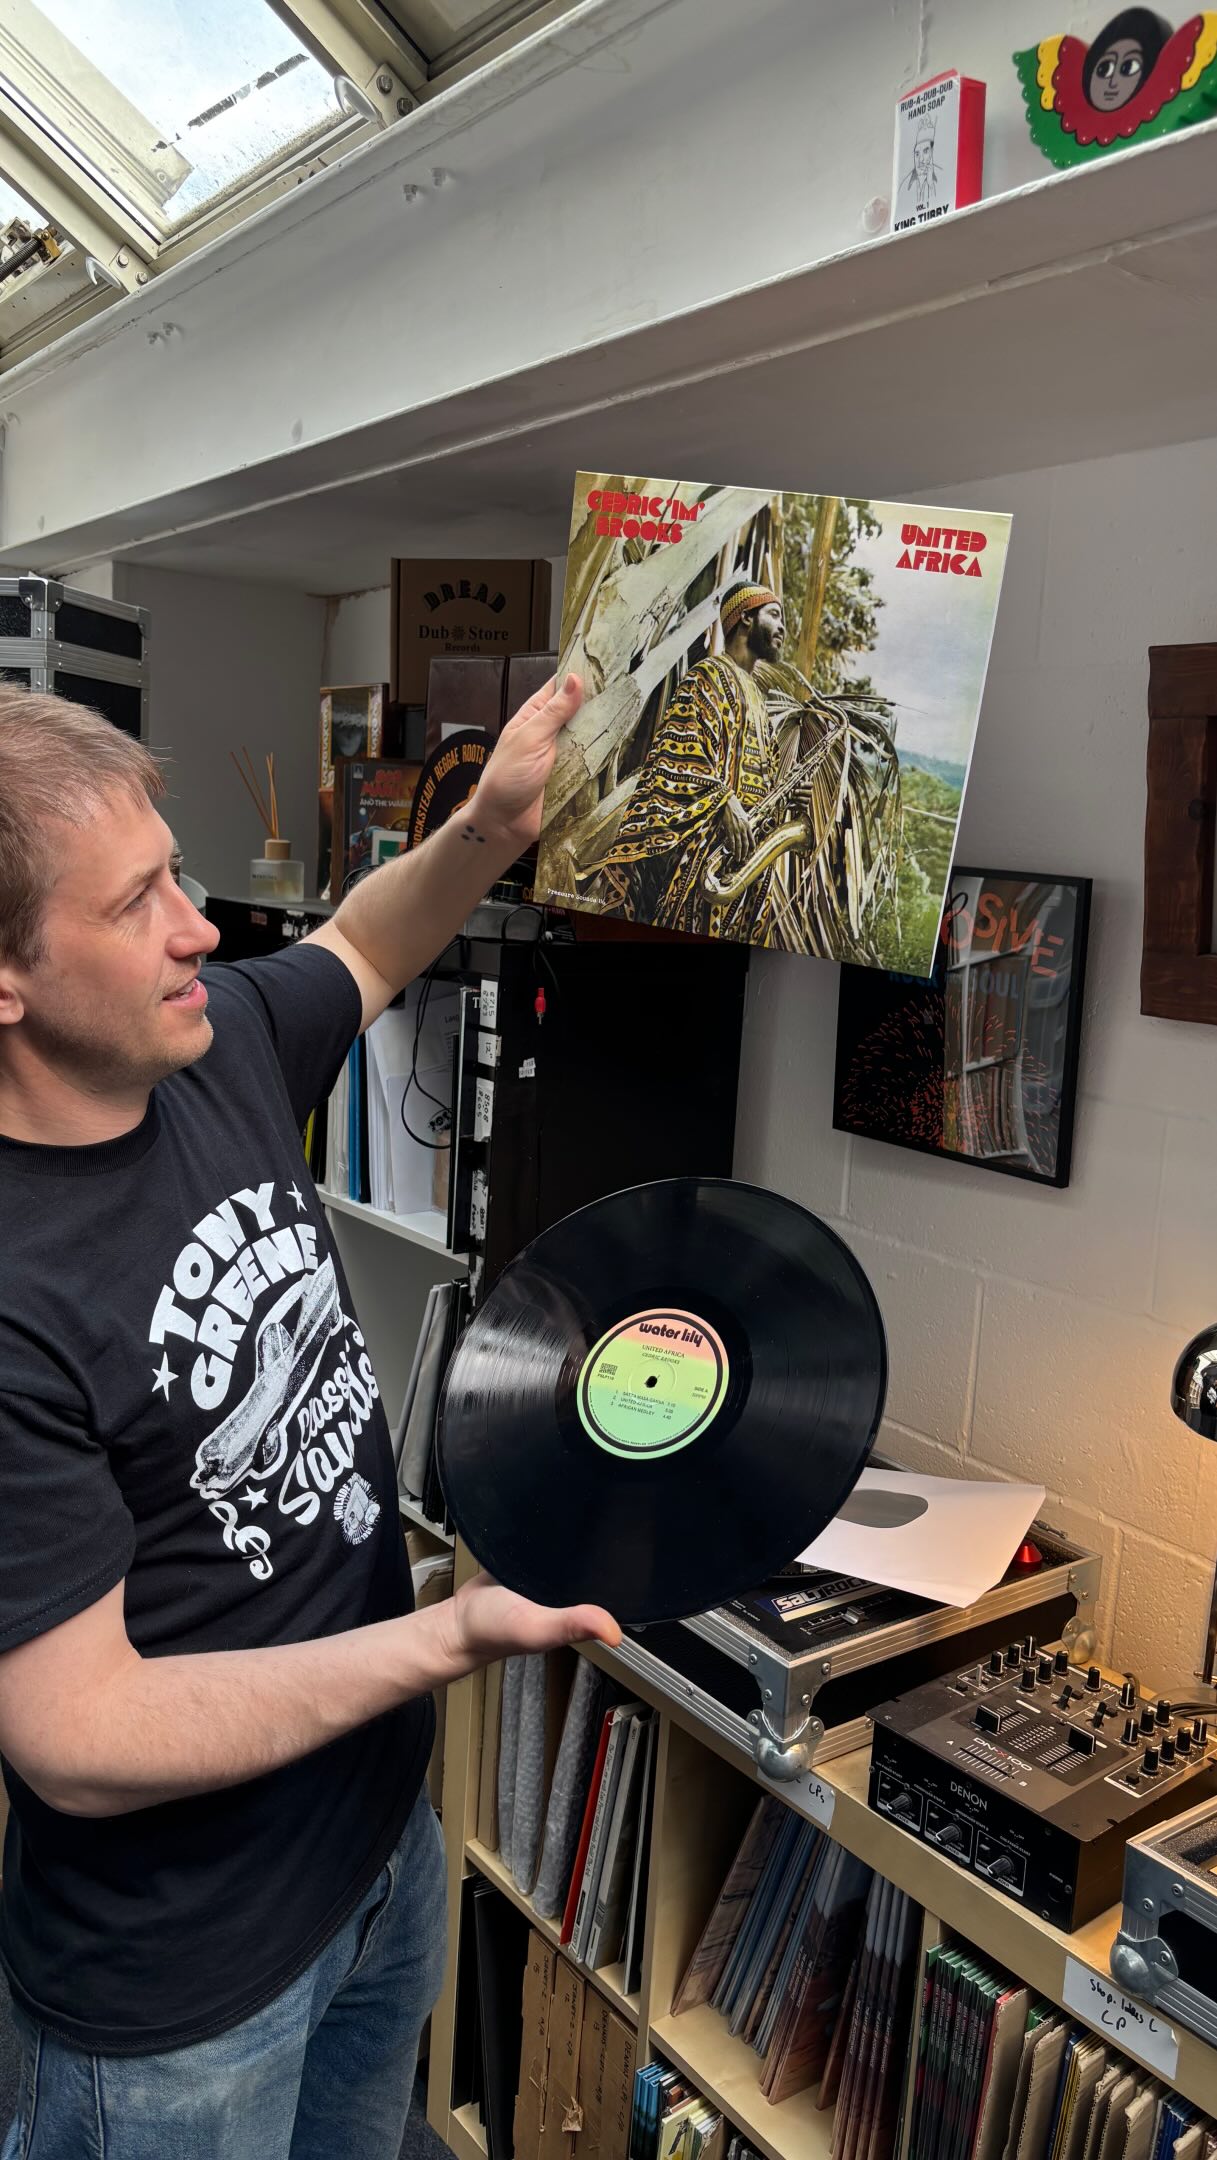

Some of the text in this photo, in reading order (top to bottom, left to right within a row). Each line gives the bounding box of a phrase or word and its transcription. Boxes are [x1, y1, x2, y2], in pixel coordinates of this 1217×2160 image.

[900, 80, 953, 112] RUB-A-DUB-DUB
[907, 96, 946, 120] HAND SOAP
[587, 490, 664, 517] CEDRIC
[595, 516, 683, 544] BROOKS
[901, 523, 987, 553] UNITED
[895, 548, 982, 577] AFRICA
[424, 579, 506, 613] DREAD
[418, 625, 509, 641] Dub Store
[434, 747, 461, 782] REGGAE
[462, 744, 486, 766] ROOTS
[547, 888, 575, 899] Pressure
[149, 1182, 275, 1345] TONY
[190, 1223, 318, 1410] GREENE
[639, 1322, 703, 1347] water lily
[641, 1344, 685, 1358] UNITED AFRICA
[333, 1483, 351, 1521] SOULSIDE
[973, 1737, 1032, 1771] DN-X100
[808, 1783, 825, 1804] LPs
[950, 1781, 987, 1811] DENON
